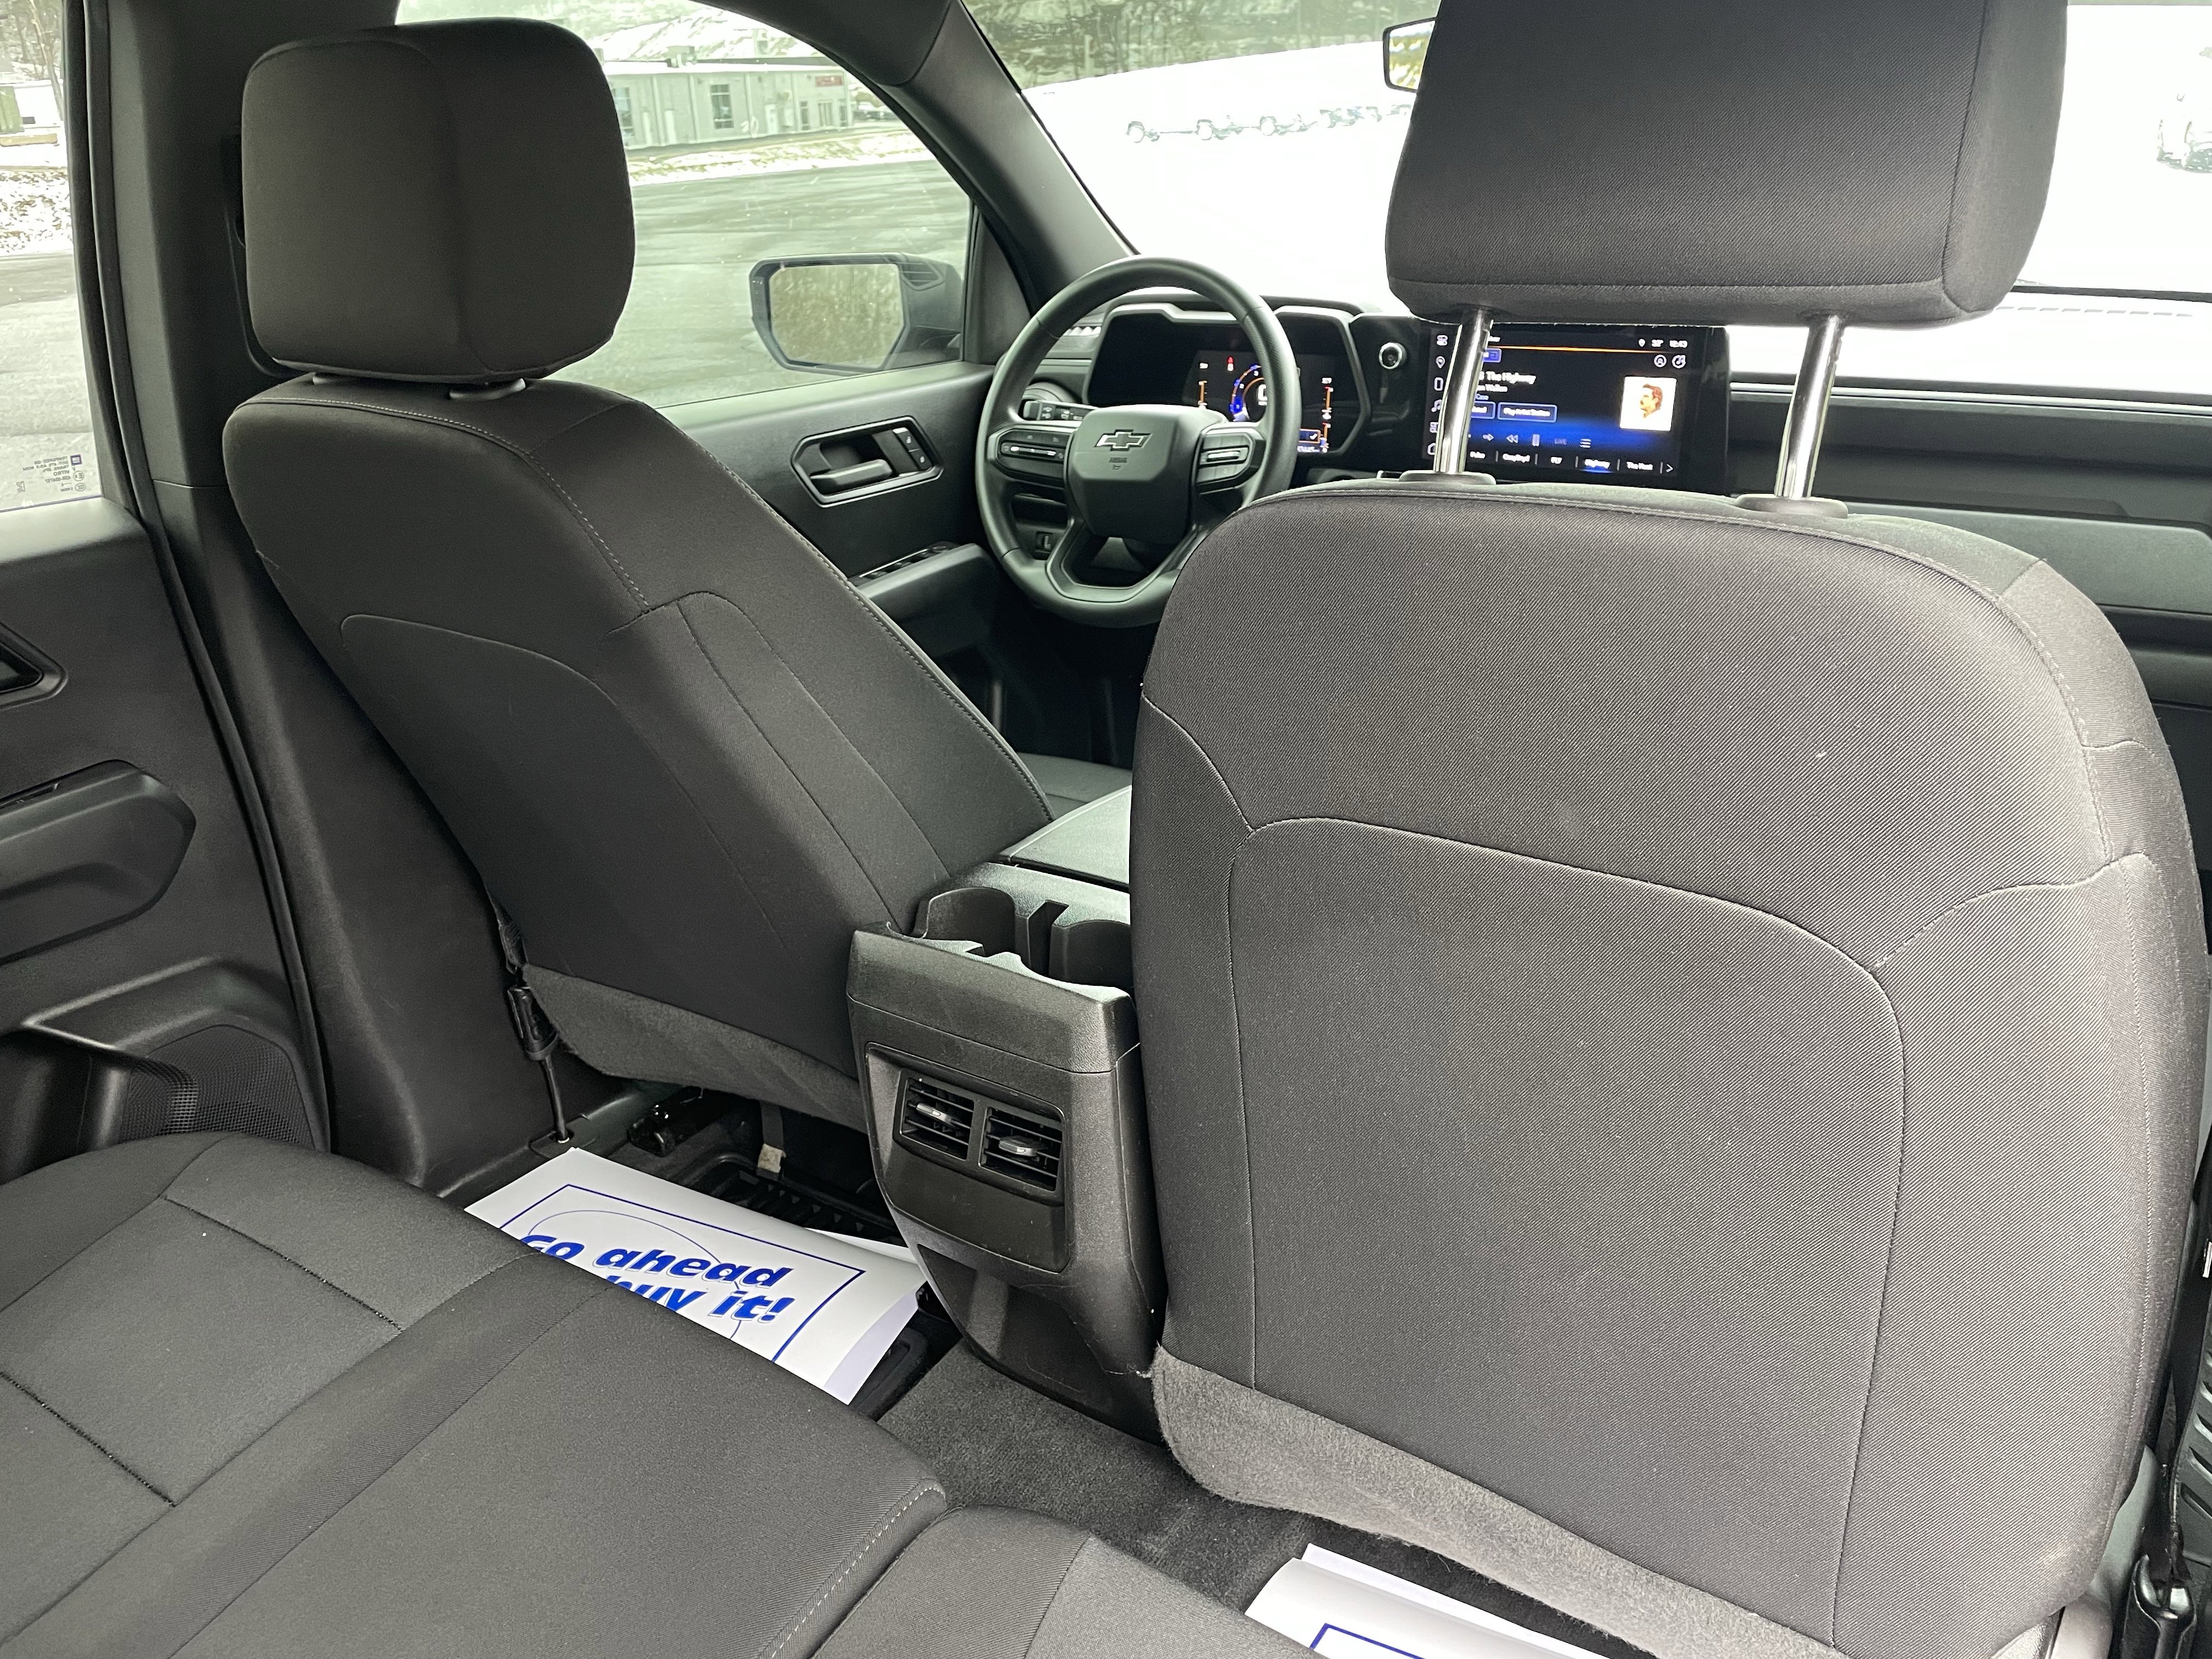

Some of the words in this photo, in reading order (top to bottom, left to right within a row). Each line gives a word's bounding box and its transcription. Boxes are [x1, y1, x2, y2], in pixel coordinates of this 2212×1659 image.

[1486, 371, 1502, 381] The
[1502, 372, 1537, 385] Highway
[592, 1248, 794, 1289] ahead
[708, 1290, 795, 1324] it!
